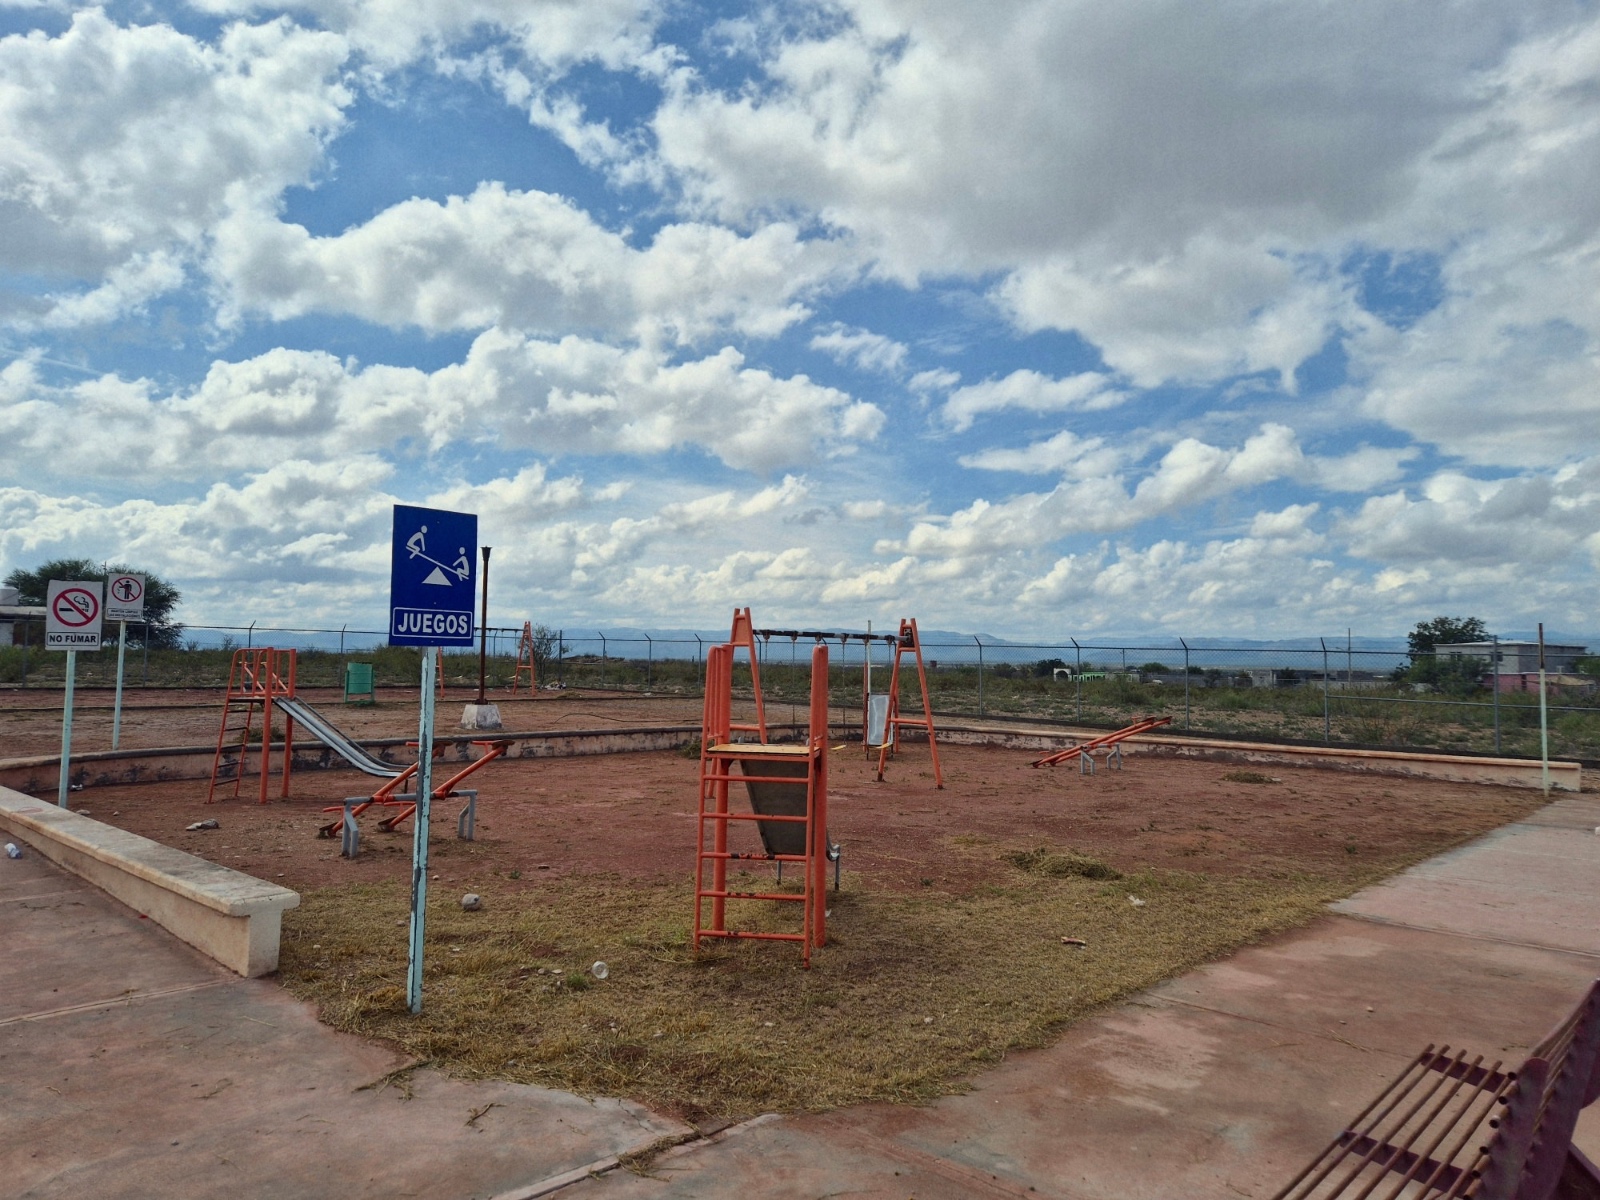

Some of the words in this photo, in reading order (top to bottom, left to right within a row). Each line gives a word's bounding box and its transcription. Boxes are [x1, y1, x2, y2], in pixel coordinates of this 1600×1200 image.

[397, 613, 468, 634] JUEGOS
[49, 635, 63, 643] NO
[65, 635, 97, 643] FUMAR
